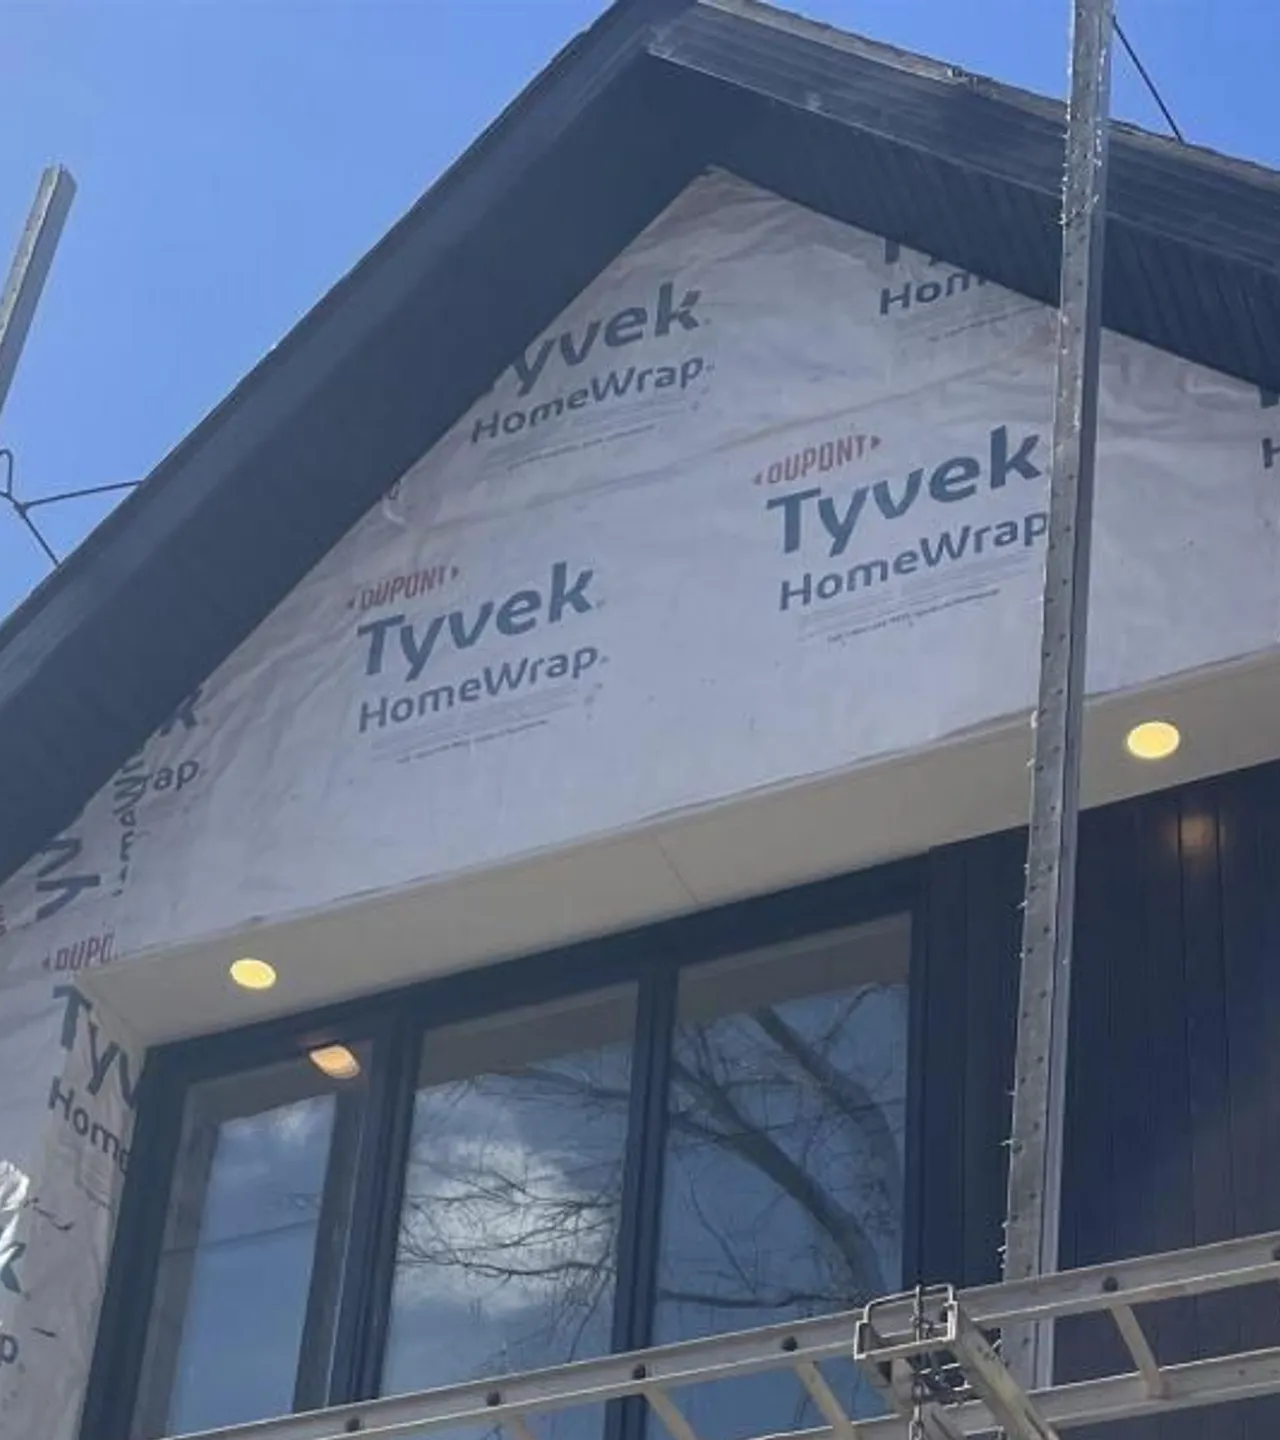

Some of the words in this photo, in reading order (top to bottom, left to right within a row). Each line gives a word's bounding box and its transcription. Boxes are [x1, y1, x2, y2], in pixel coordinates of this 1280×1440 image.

[471, 357, 704, 443] HomeWrap
[766, 425, 1042, 558] Tyvek
[767, 433, 866, 485] DUPONT
[361, 565, 446, 611] DUPONT
[780, 511, 1048, 612] HomeWrap
[357, 561, 593, 682] Tyvek
[358, 646, 598, 734] HomeWrap
